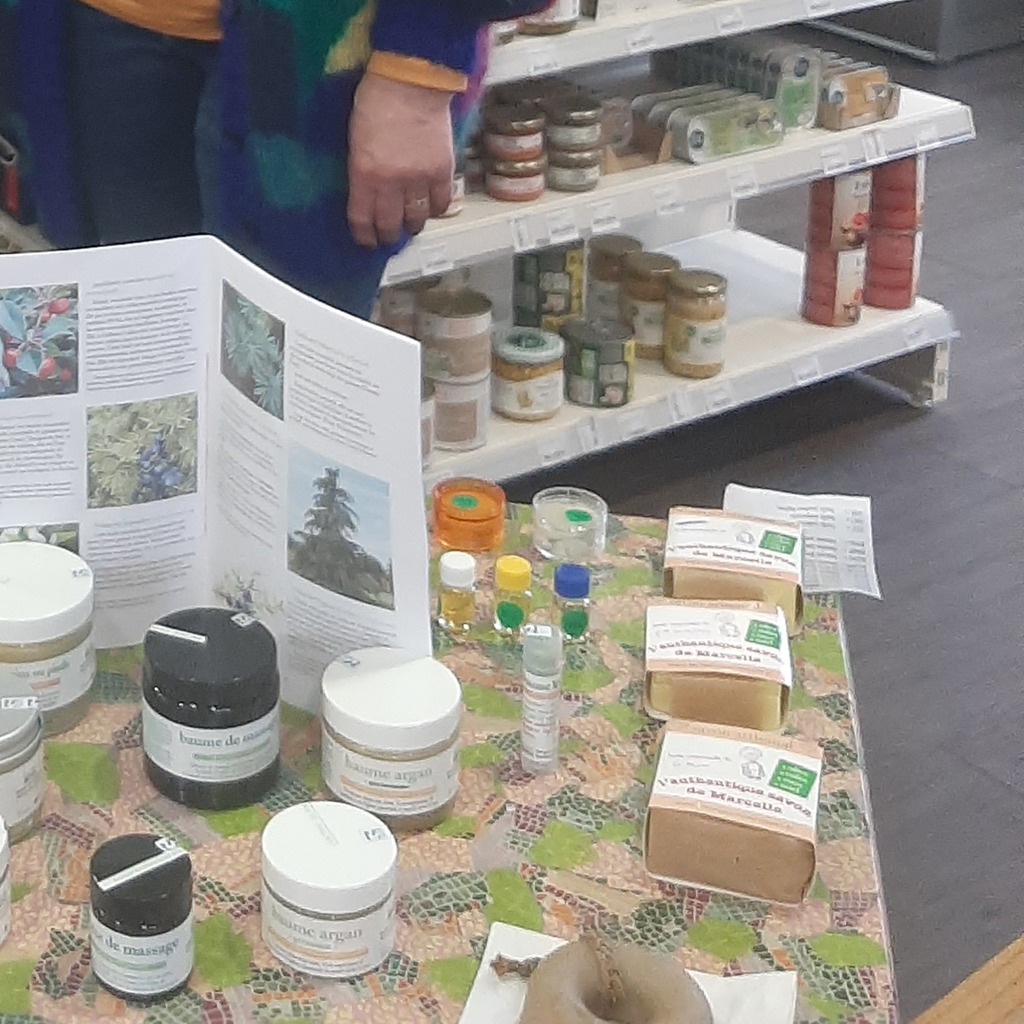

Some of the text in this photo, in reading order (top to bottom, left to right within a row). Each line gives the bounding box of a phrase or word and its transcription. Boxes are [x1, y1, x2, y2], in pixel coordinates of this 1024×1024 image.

[179, 730, 223, 748] baume
[225, 734, 241, 746] de
[318, 928, 363, 943] argan
[104, 936, 180, 957] de massage
